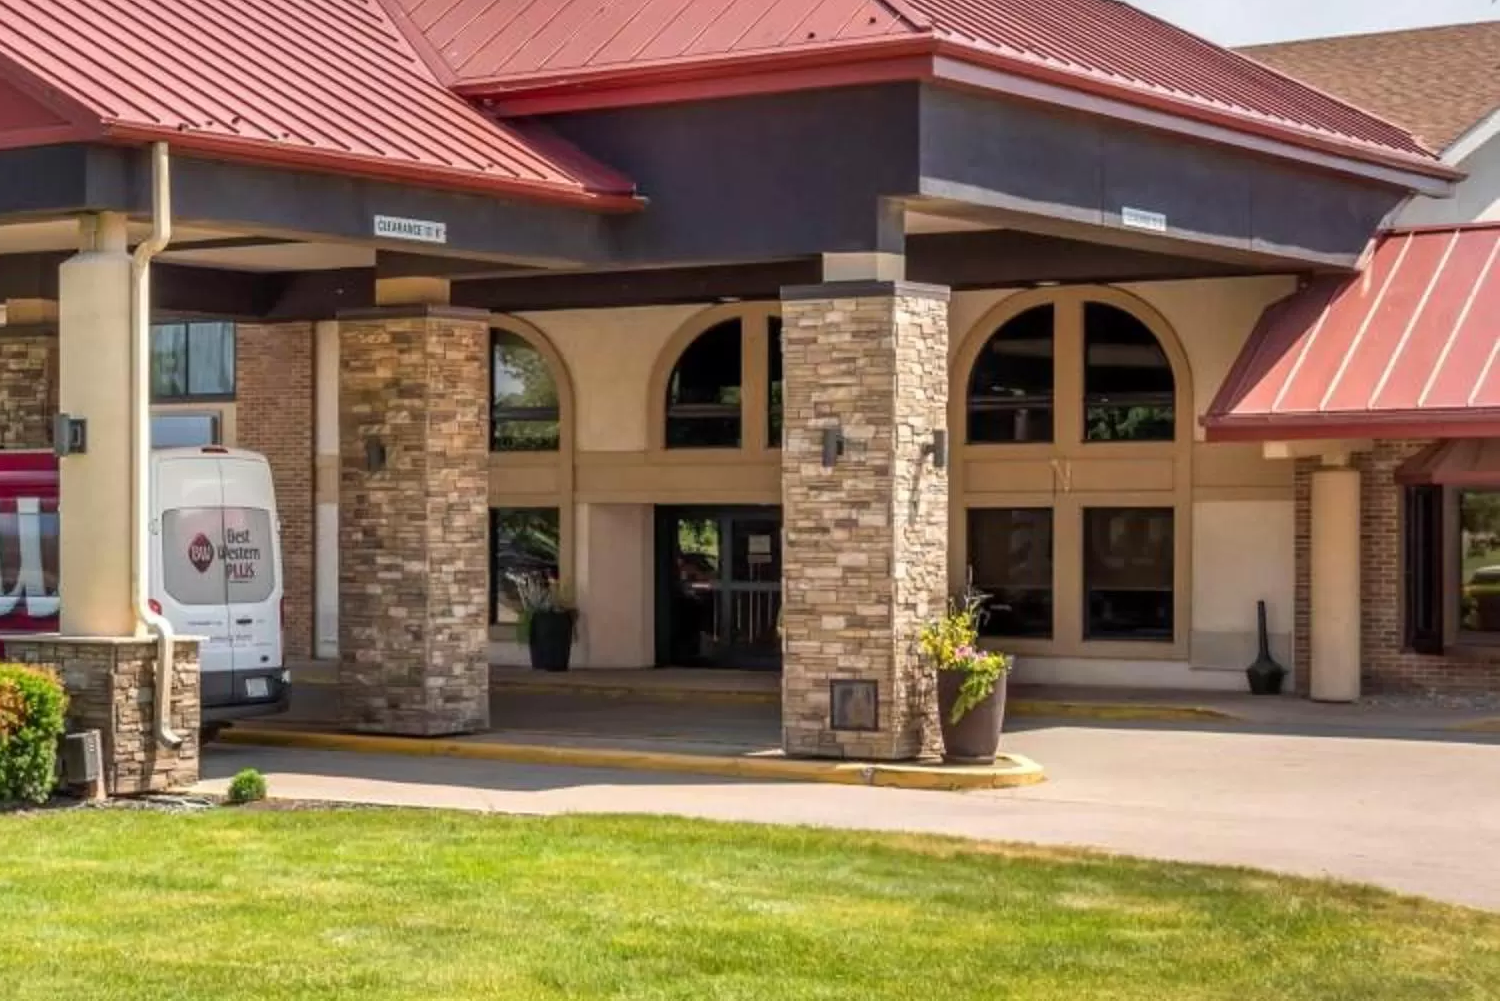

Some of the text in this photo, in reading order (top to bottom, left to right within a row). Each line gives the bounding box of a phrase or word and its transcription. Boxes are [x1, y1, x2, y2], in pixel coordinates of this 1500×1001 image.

[226, 528, 251, 544] Best
[217, 546, 261, 560] Western
[226, 562, 256, 580] PLUS
